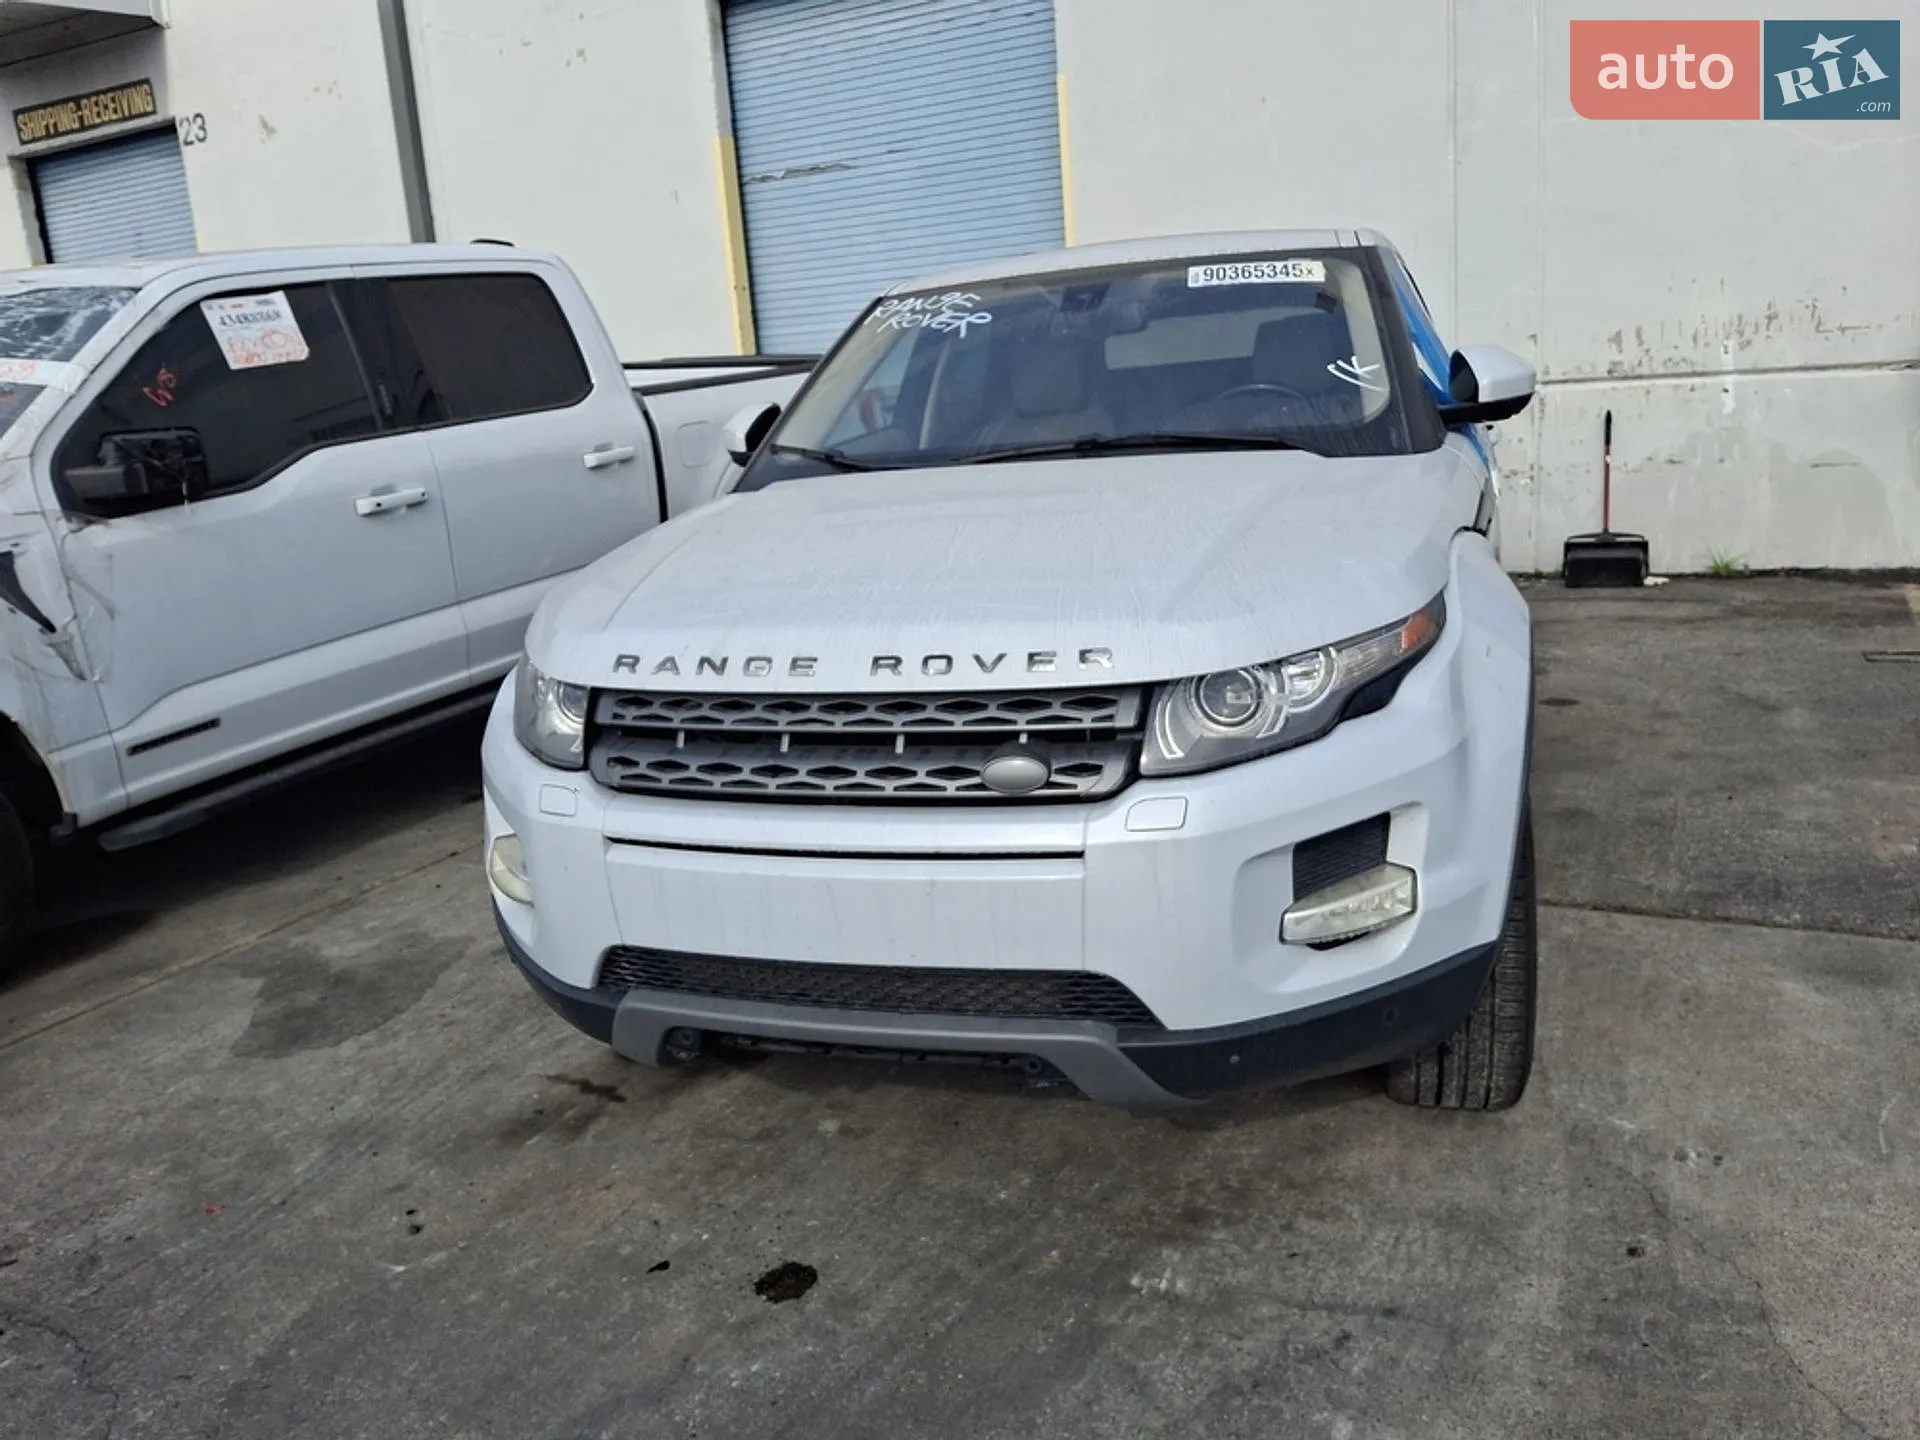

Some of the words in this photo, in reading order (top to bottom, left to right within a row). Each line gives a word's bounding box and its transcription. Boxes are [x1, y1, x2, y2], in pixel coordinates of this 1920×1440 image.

[17, 84, 154, 141] SHIPPING-RECEIVING
[179, 112, 208, 146] 23
[612, 653, 819, 677] RANGE
[871, 647, 1115, 676] ROVER
